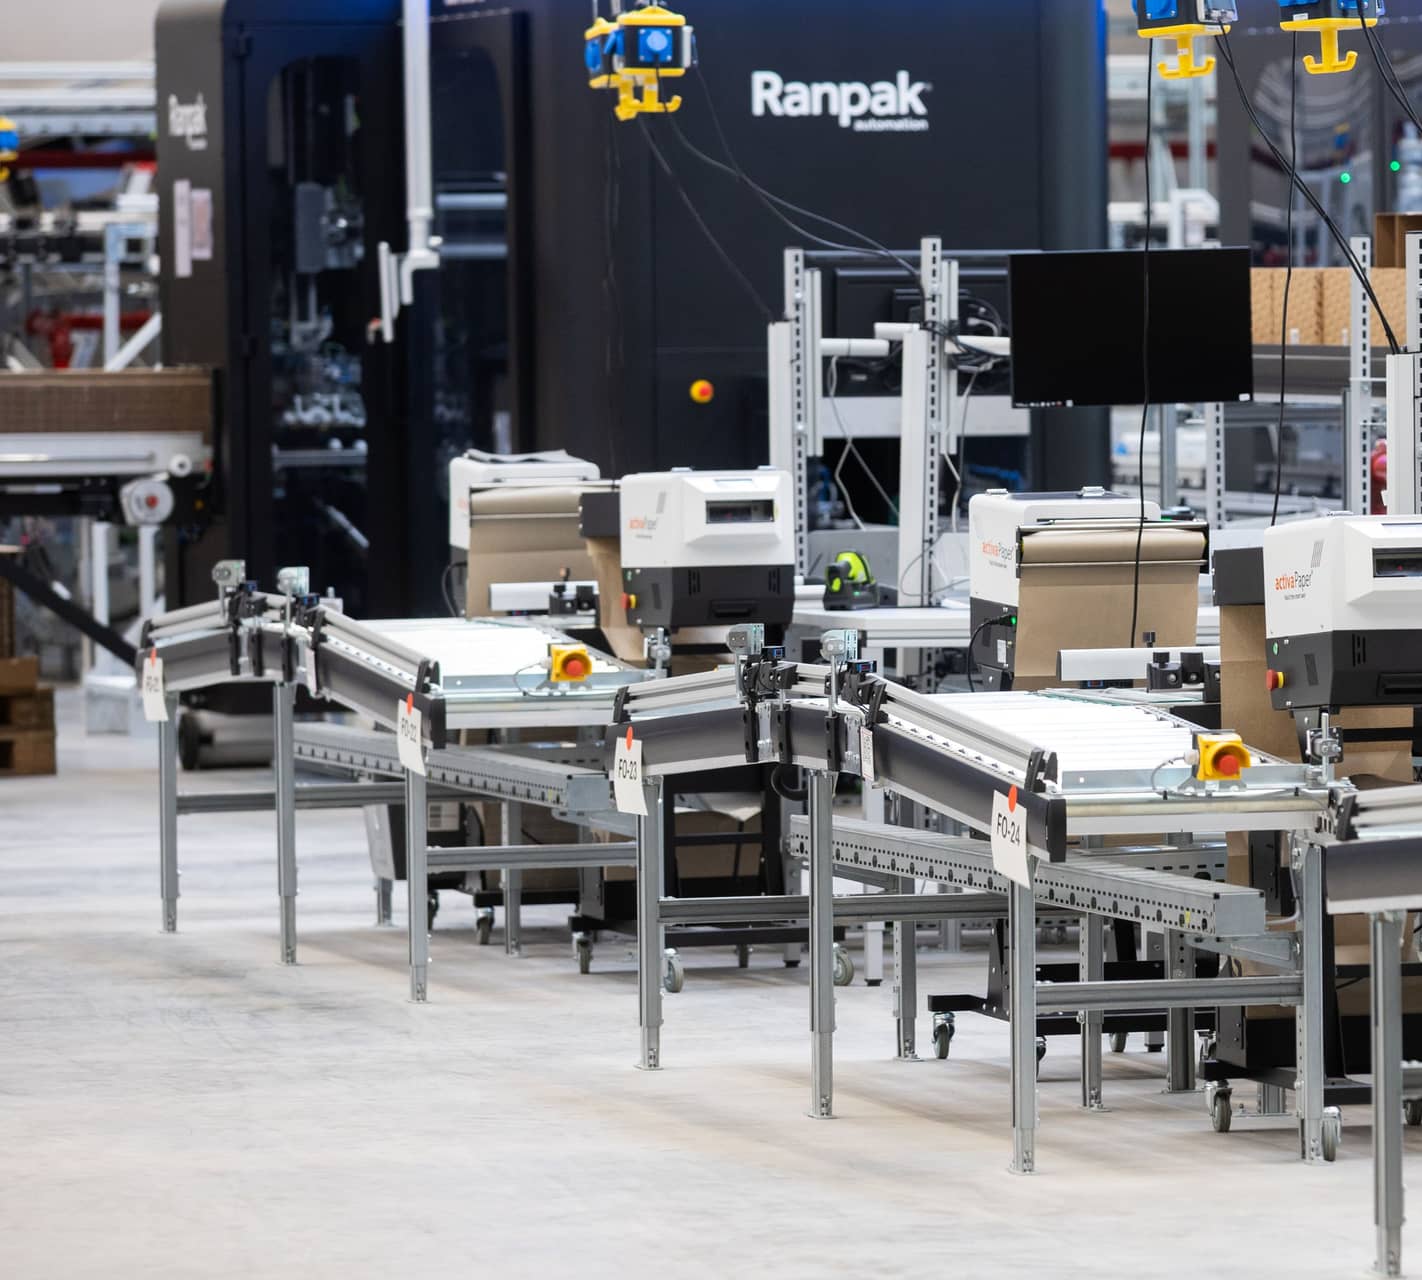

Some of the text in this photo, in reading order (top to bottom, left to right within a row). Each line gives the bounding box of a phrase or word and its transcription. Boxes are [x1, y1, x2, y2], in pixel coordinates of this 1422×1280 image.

[751, 70, 928, 128] Ranpak
[853, 118, 929, 131] automation
[1275, 570, 1312, 592] activaPaper
[618, 758, 638, 781] FO-23
[996, 811, 1021, 847] FO-24
